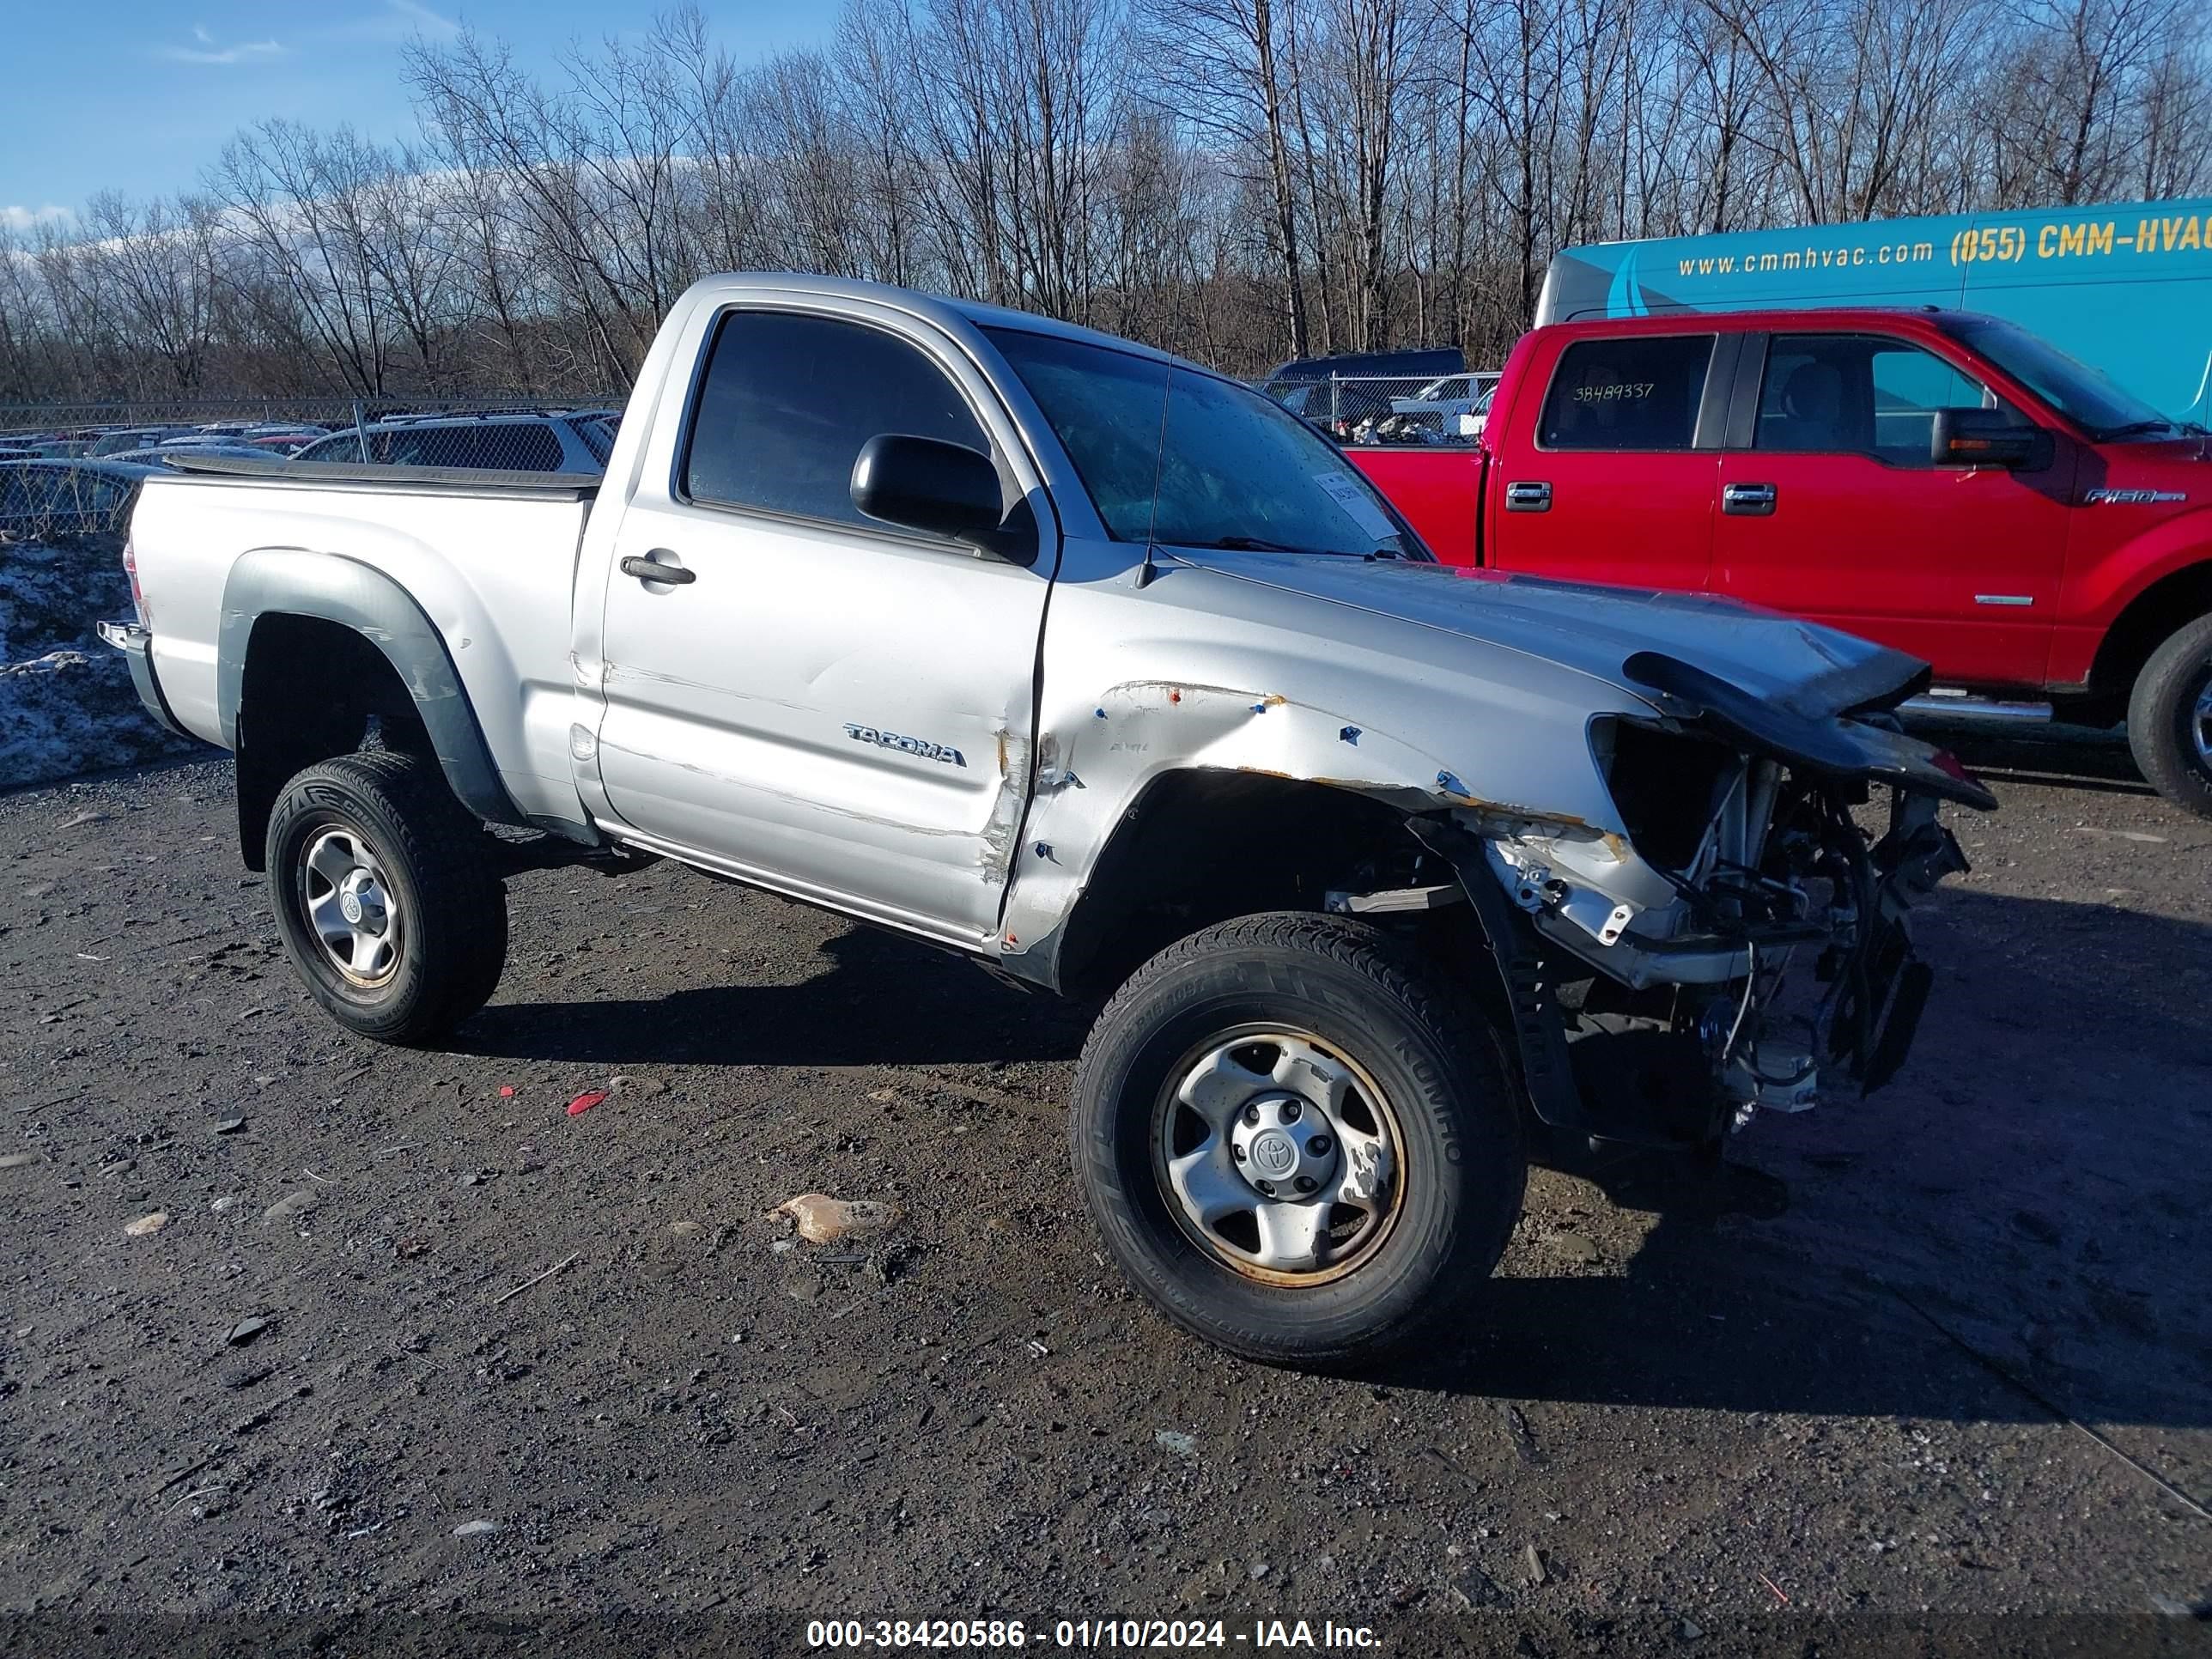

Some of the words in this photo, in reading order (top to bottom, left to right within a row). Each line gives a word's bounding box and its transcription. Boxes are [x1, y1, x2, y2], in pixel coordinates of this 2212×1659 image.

[1679, 241, 1933, 276] www.cmmhvac.com
[1950, 227, 2027, 267] (855)
[1572, 383, 1655, 404] 38489337
[842, 722, 968, 768] TACOMA
[1394, 1036, 1463, 1165] KUMHO
